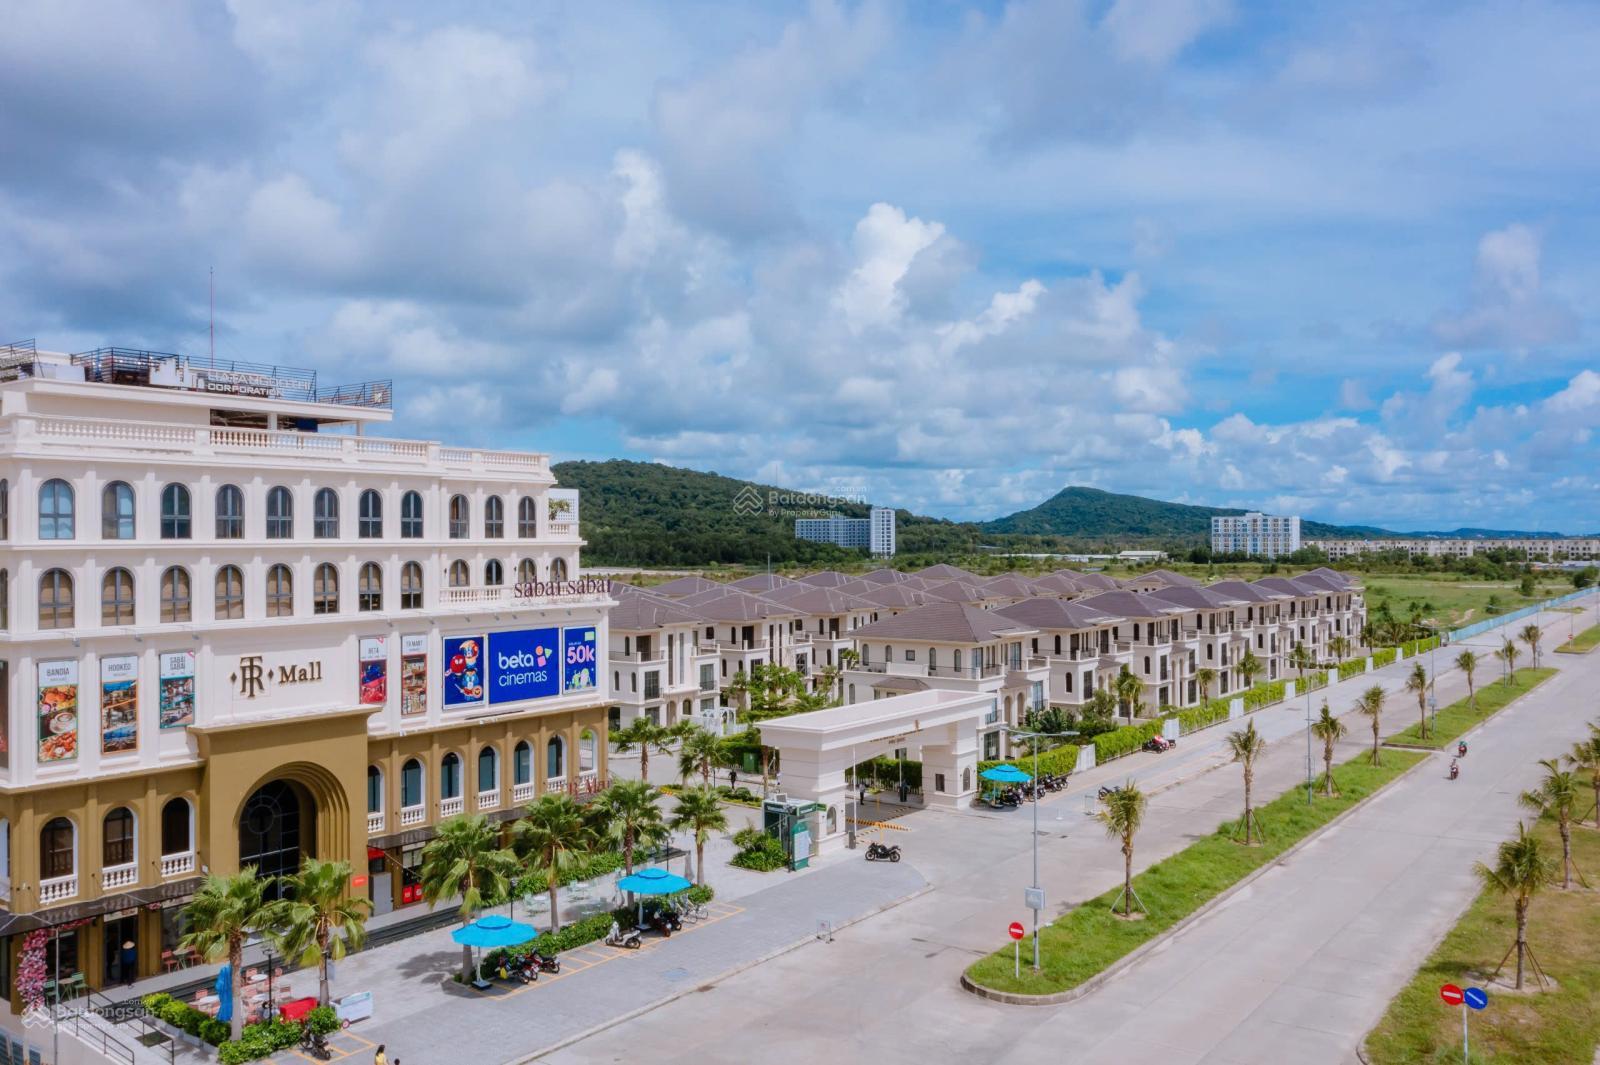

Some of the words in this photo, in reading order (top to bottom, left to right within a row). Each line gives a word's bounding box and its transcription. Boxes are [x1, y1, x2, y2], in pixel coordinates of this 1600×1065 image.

[207, 382, 285, 397] CORPORATION
[514, 576, 560, 598] sabai
[567, 573, 611, 595] sabai
[498, 650, 534, 670] beta
[566, 645, 595, 664] 50k
[278, 661, 323, 684] Mall
[498, 670, 548, 687] cinemas
